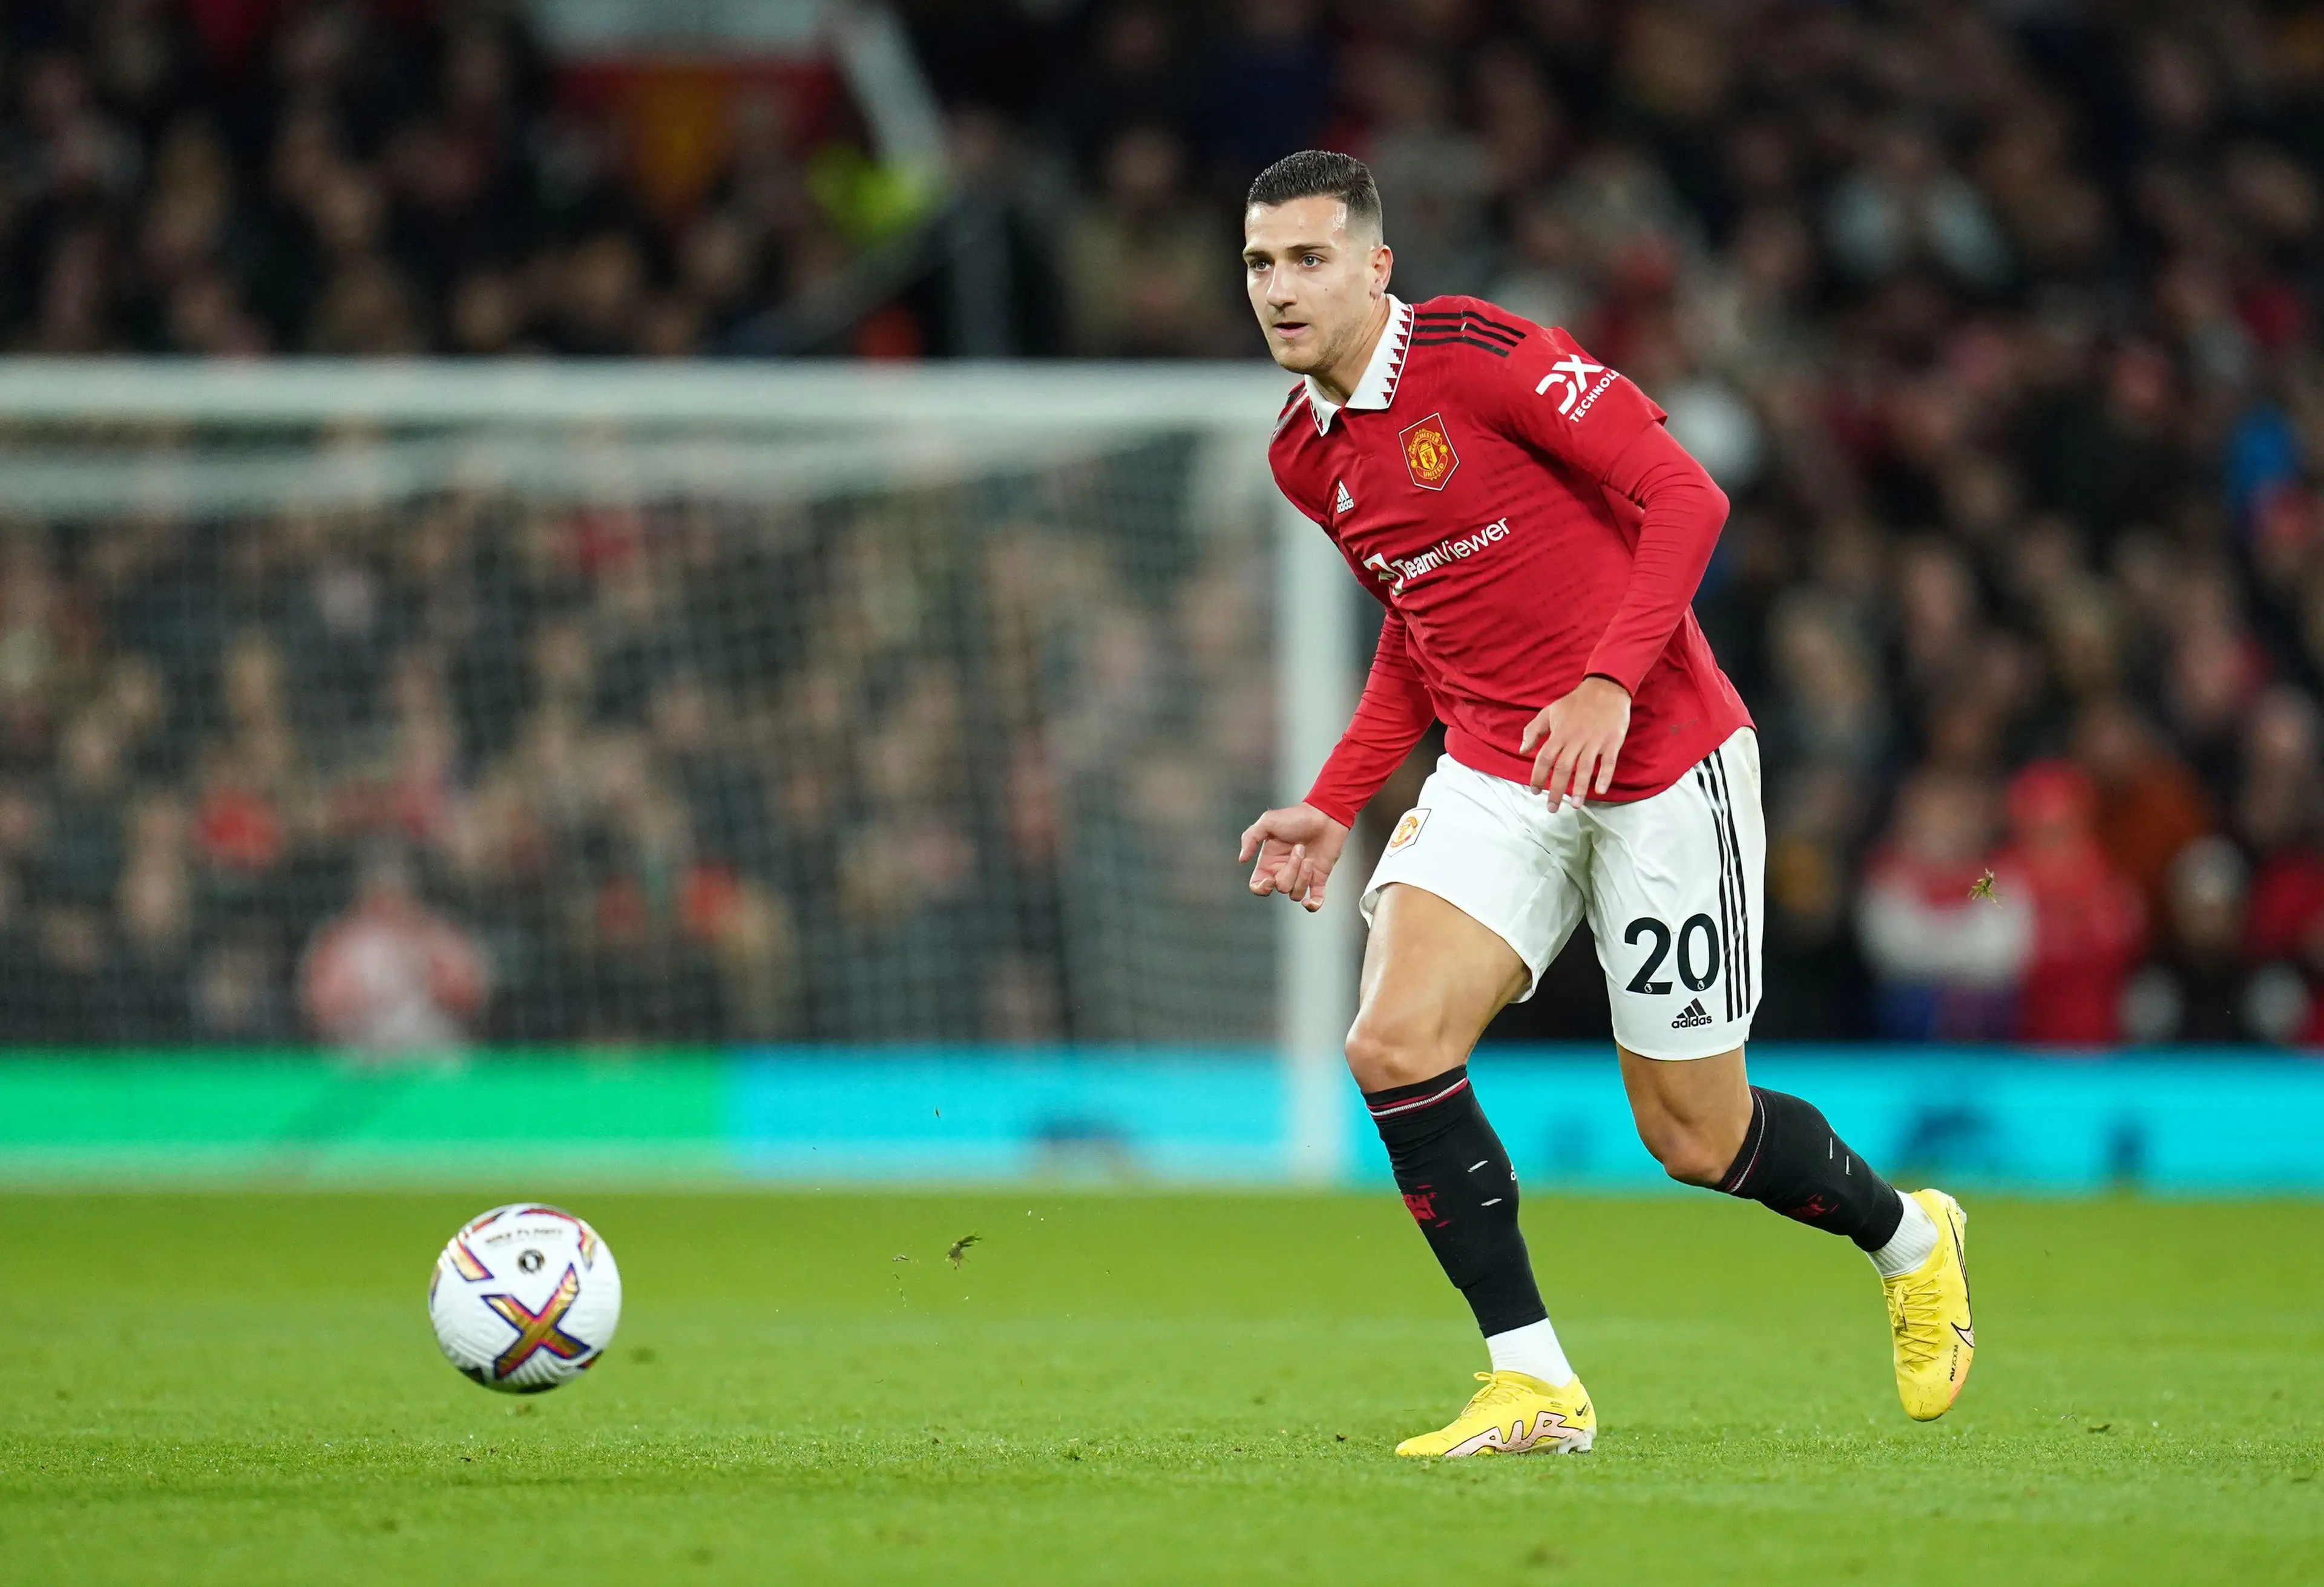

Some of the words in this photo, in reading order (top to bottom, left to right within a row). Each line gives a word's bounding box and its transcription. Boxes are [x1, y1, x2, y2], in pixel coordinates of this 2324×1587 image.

[1411, 431, 1440, 455] MANCHESTER
[1423, 462, 1444, 477] UNITED
[1337, 498, 1354, 514] adidas
[1390, 517, 1511, 581] TeamViewer
[1624, 913, 1720, 995] 20
[1671, 1015, 1713, 1029] adidas
